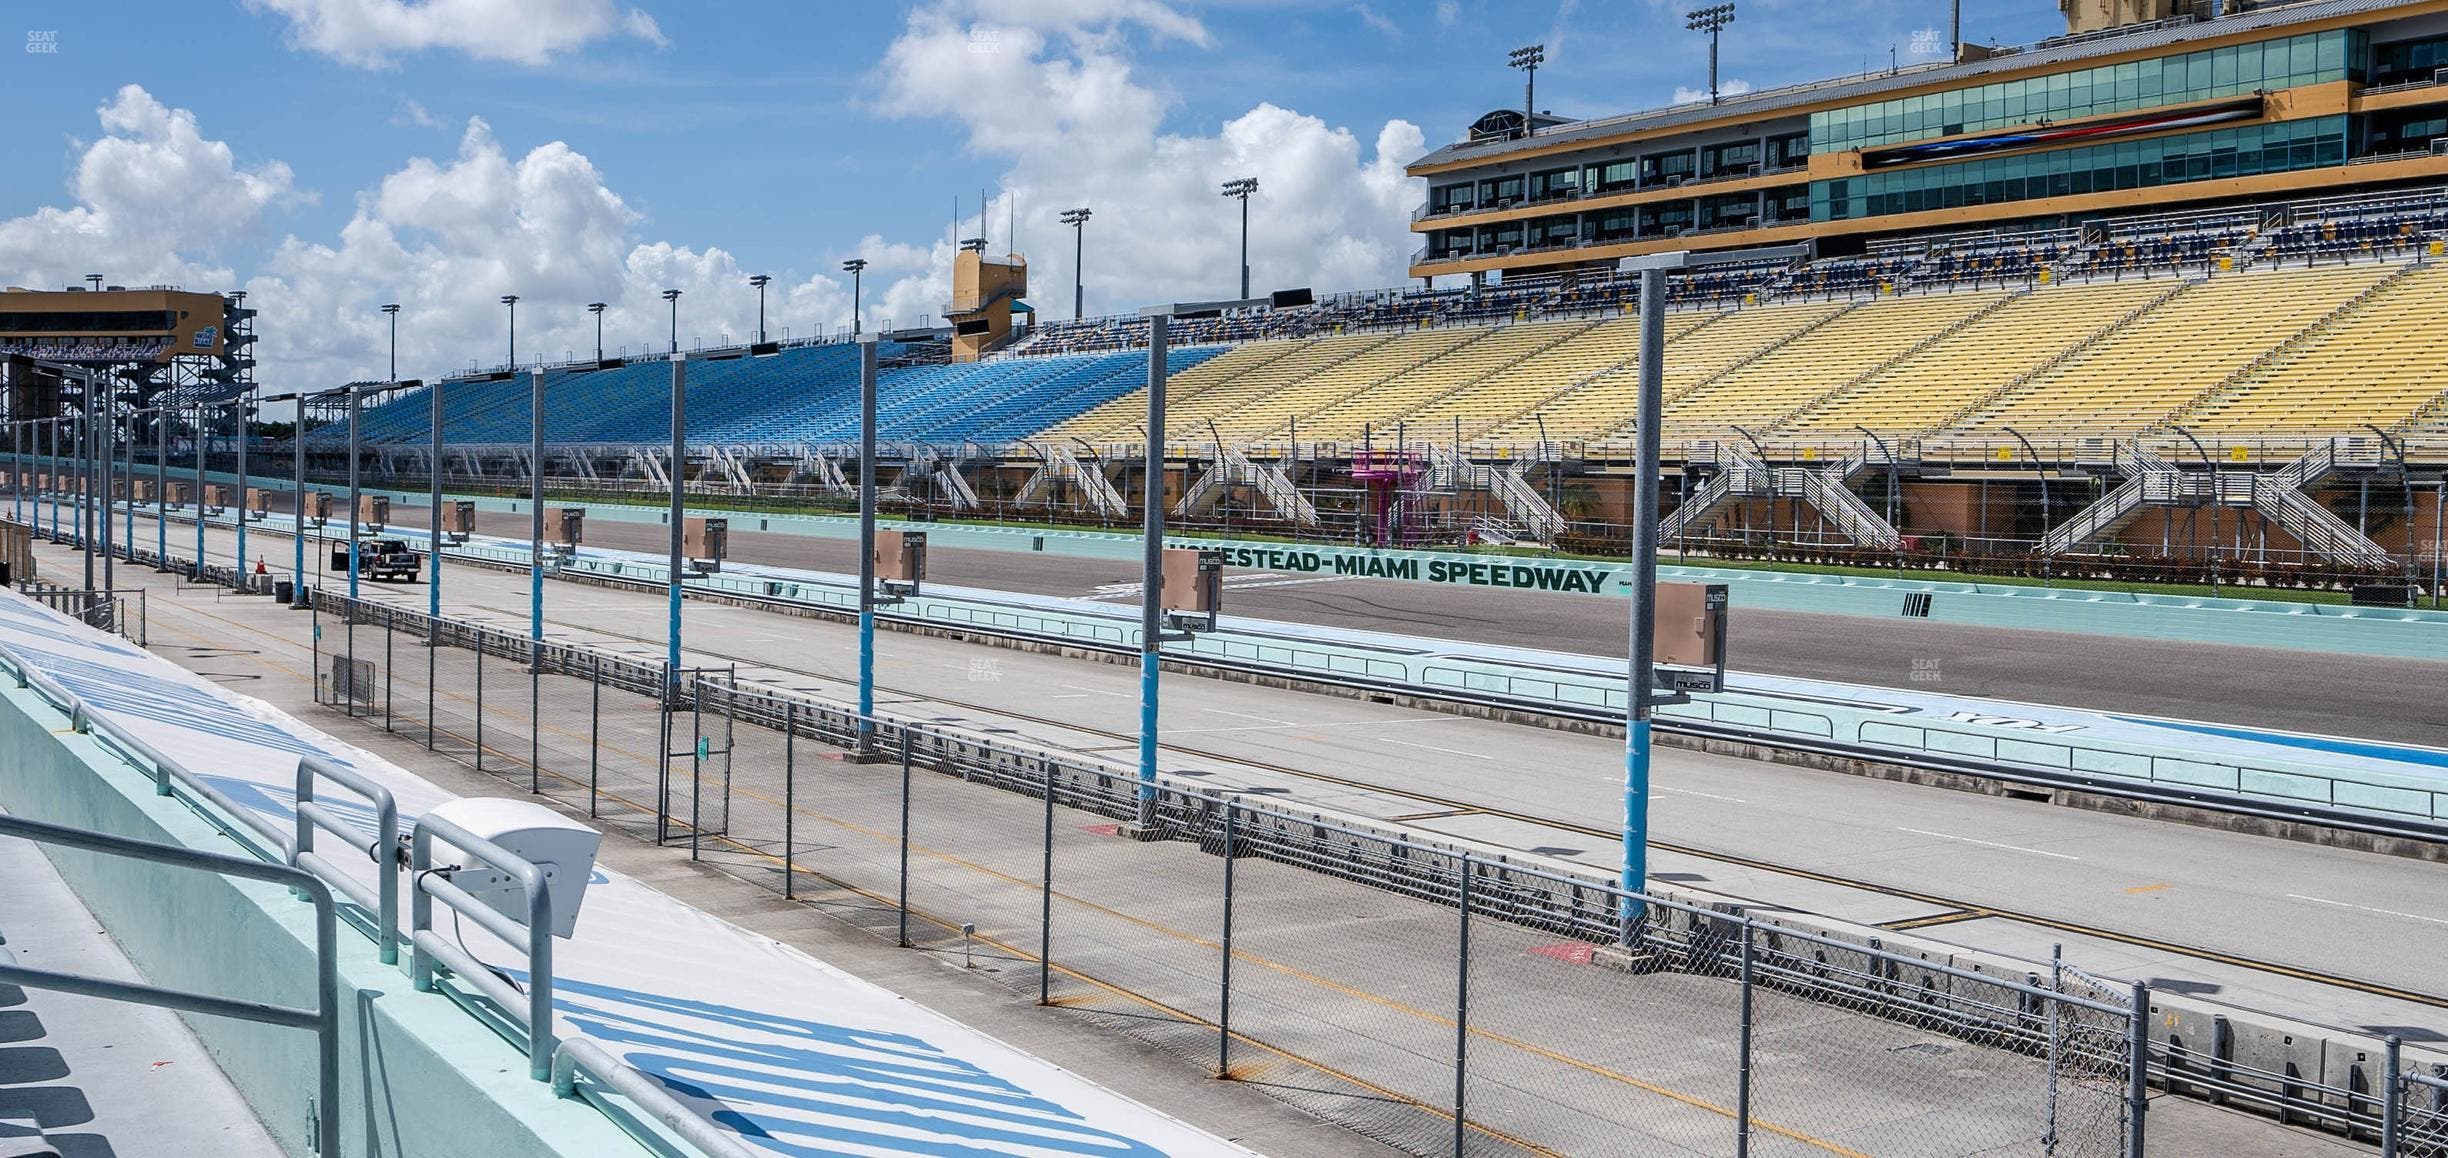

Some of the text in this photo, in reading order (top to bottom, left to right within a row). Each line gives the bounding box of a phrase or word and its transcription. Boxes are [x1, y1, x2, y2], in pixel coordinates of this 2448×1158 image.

[1428, 561, 1610, 593] SPEEDWAY
[1706, 591, 1726, 602] musco
[1675, 680, 1711, 690] musco
